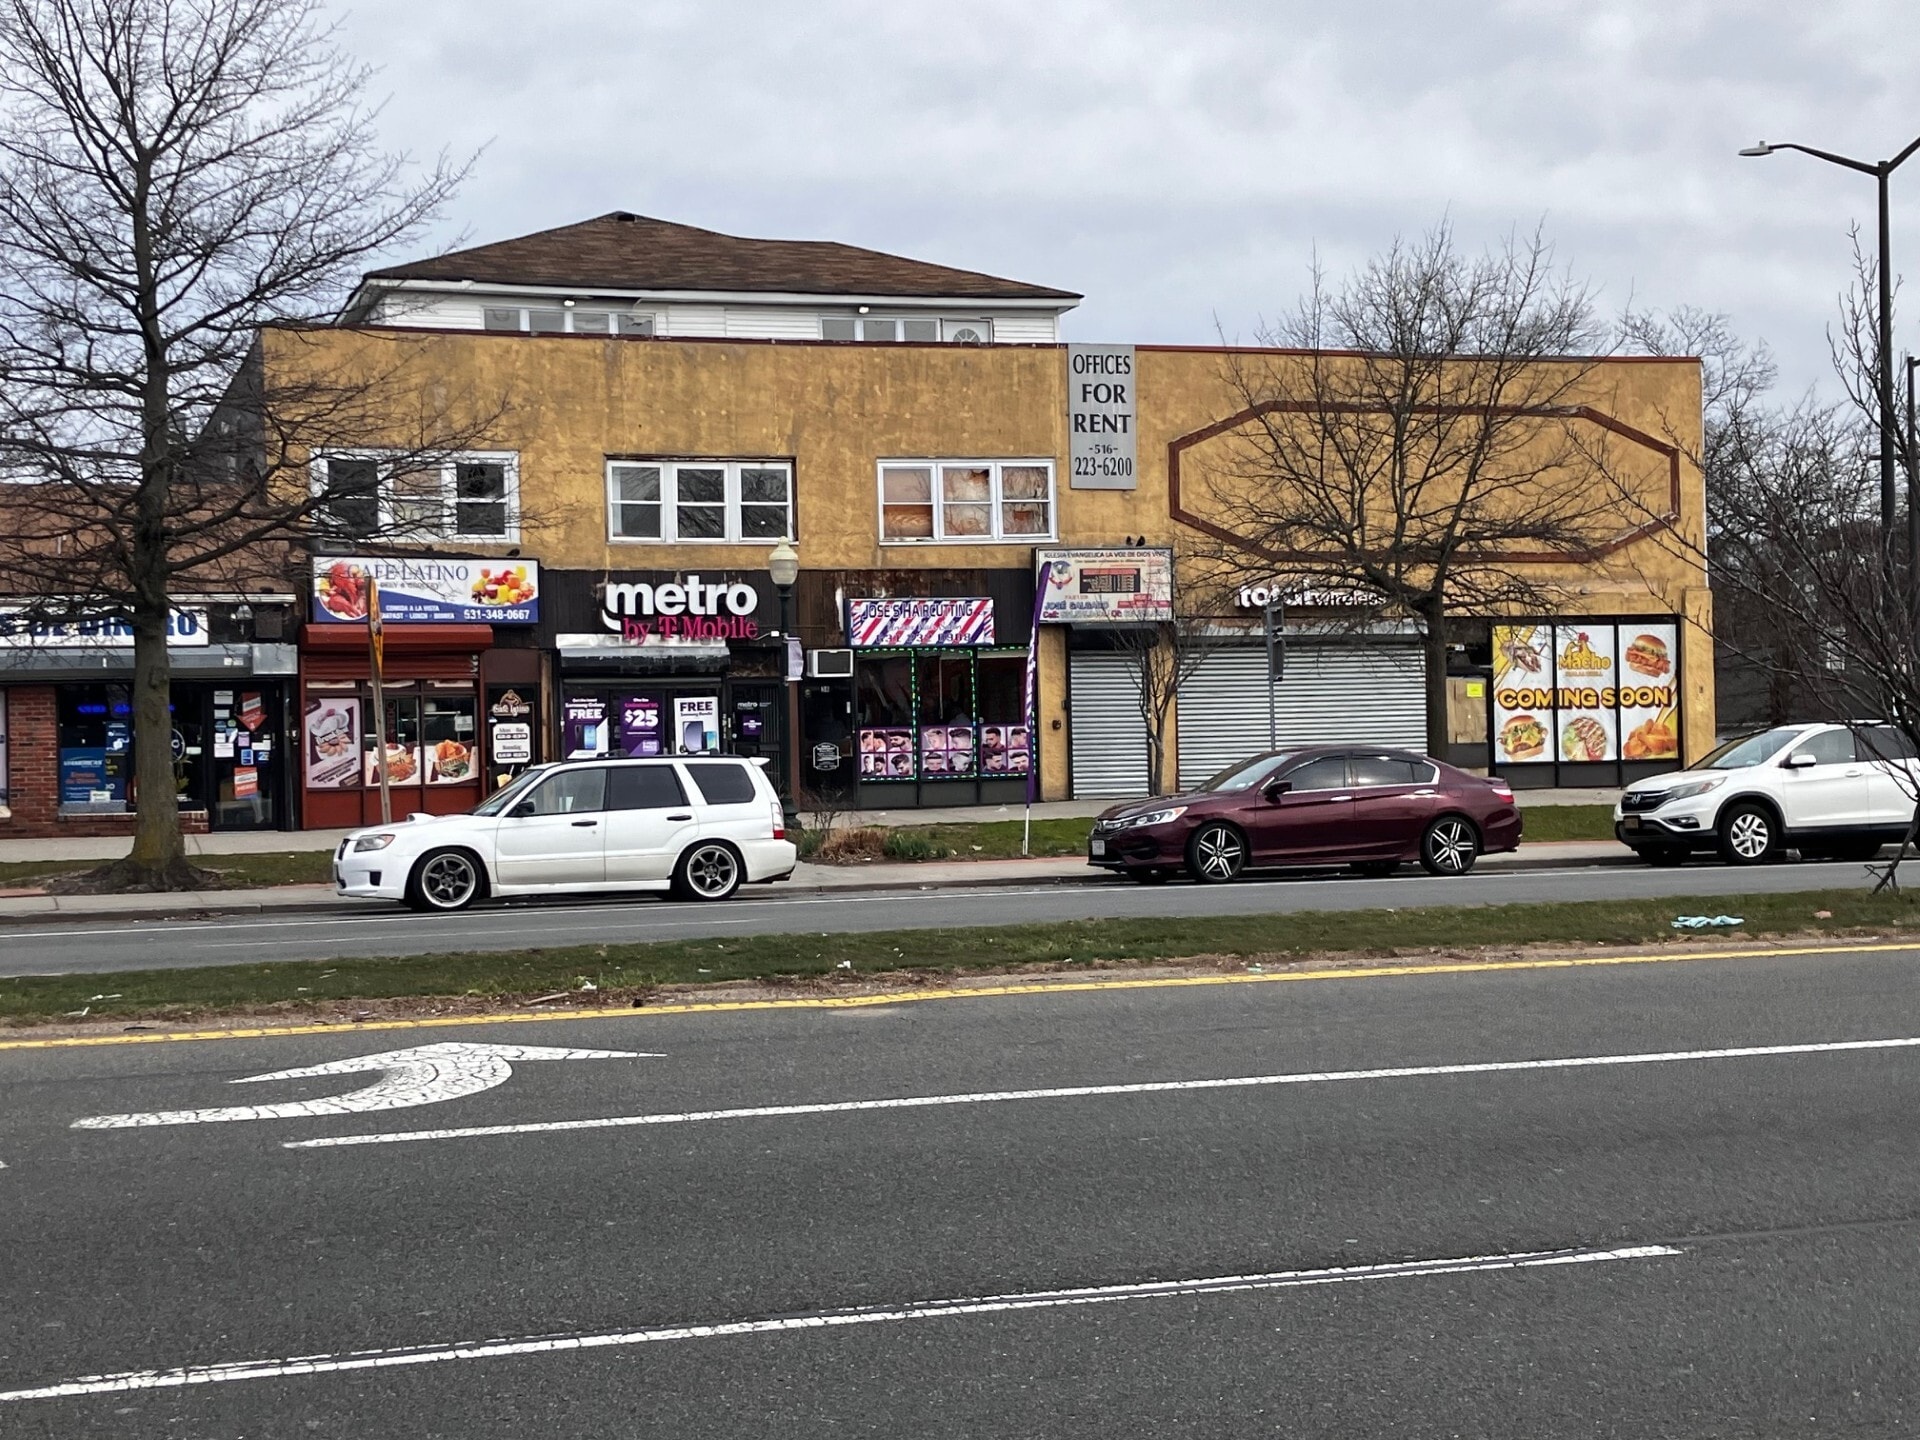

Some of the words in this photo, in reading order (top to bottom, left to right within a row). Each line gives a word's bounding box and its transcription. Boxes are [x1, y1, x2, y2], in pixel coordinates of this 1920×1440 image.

[1073, 354, 1131, 375] OFFICES
[1082, 383, 1127, 404] FOR
[1074, 413, 1131, 433] RENT
[1075, 456, 1132, 477] 223-6200
[348, 564, 399, 580] CAFE
[402, 565, 469, 581] LATINO
[605, 575, 758, 616] metro
[624, 617, 653, 645] by
[1558, 652, 1612, 670] Macho
[680, 701, 713, 712] FREE
[1498, 687, 1600, 710] COMING
[1600, 686, 1672, 708] SOON
[569, 708, 603, 720] FREE
[624, 709, 659, 727] $25
